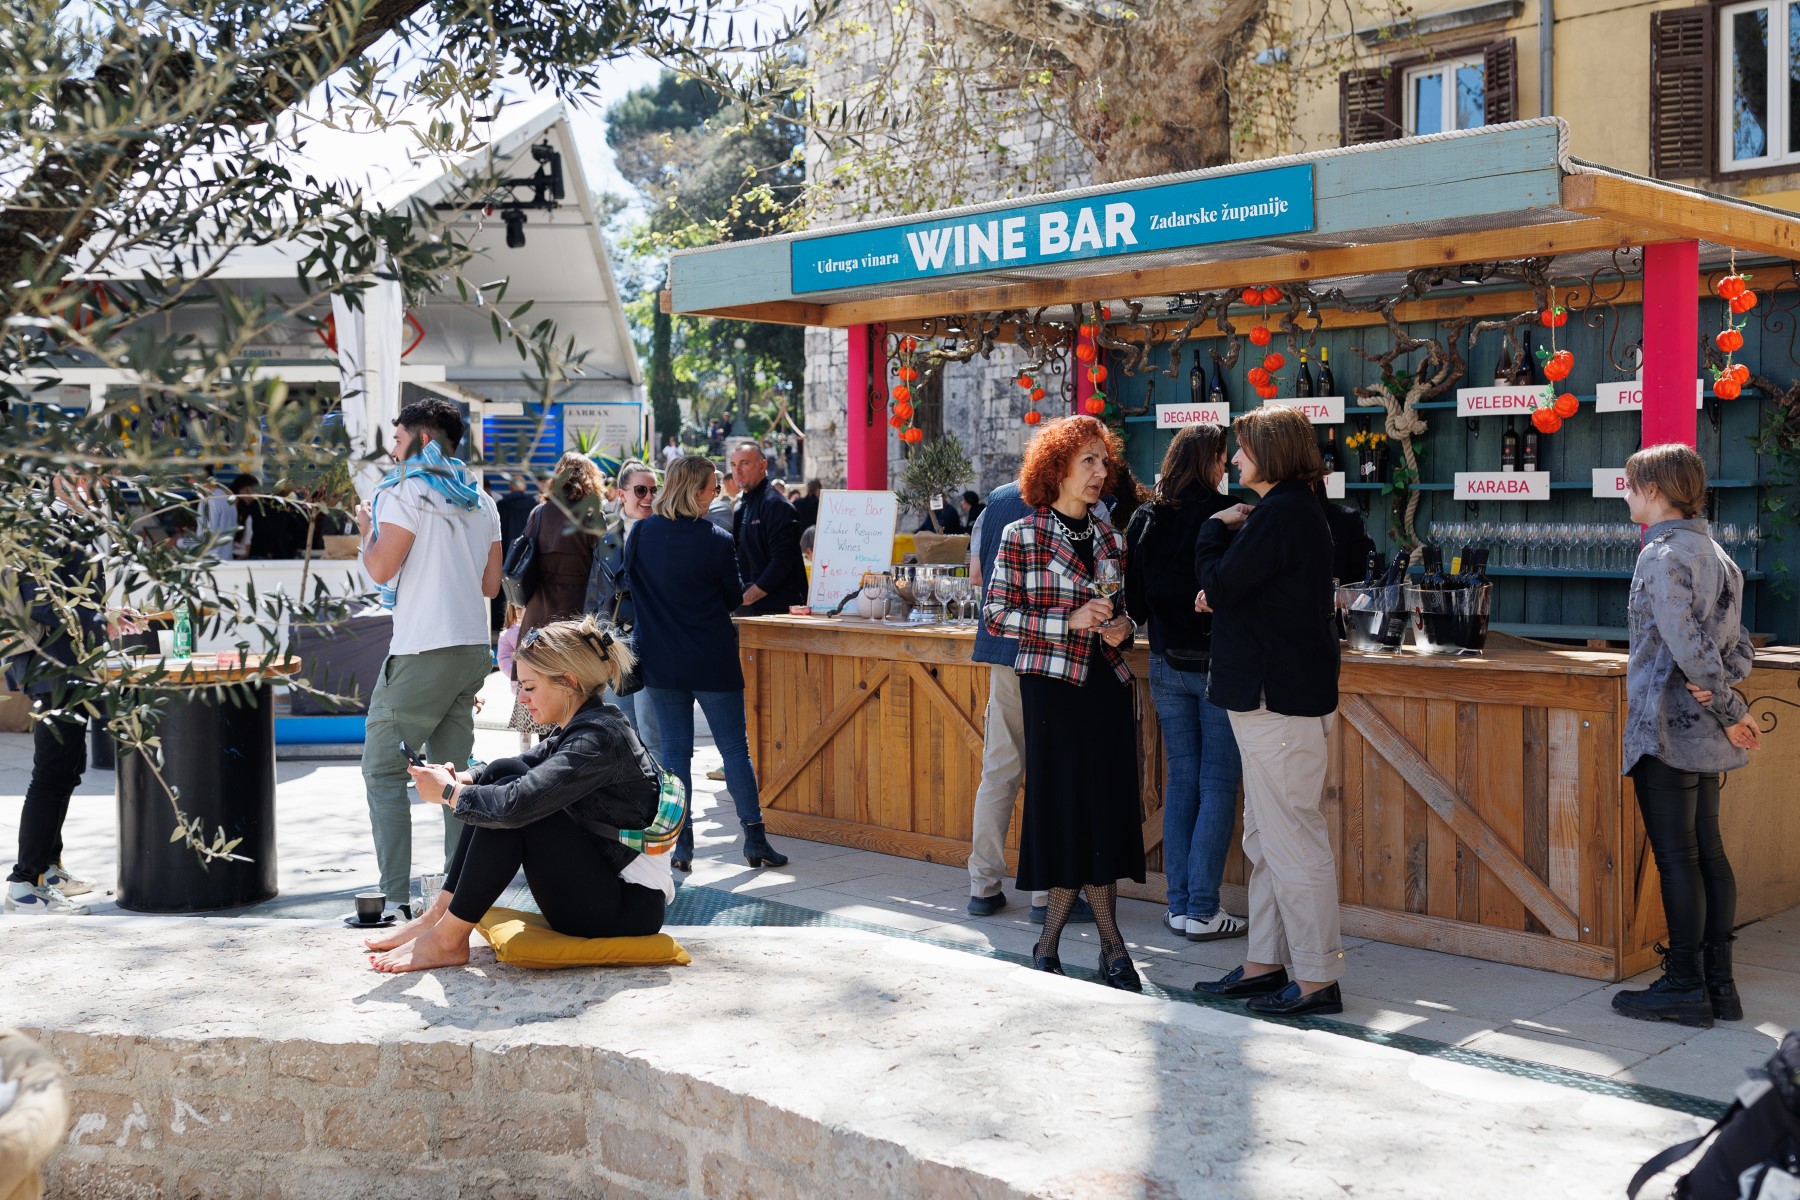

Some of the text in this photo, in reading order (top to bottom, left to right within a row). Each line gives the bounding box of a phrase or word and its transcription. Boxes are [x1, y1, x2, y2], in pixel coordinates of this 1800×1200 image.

[1149, 196, 1290, 232] Zadarske županije
[905, 201, 1139, 271] WINE BAR
[816, 251, 899, 275] Udruga vinara
[1466, 394, 1538, 410] VELEBNA
[1163, 410, 1220, 424] DEGARRA
[1467, 480, 1531, 494] KARABA
[829, 496, 885, 516] Wine Bar
[823, 520, 883, 545] Zadar Region
[837, 537, 862, 552] Wines
